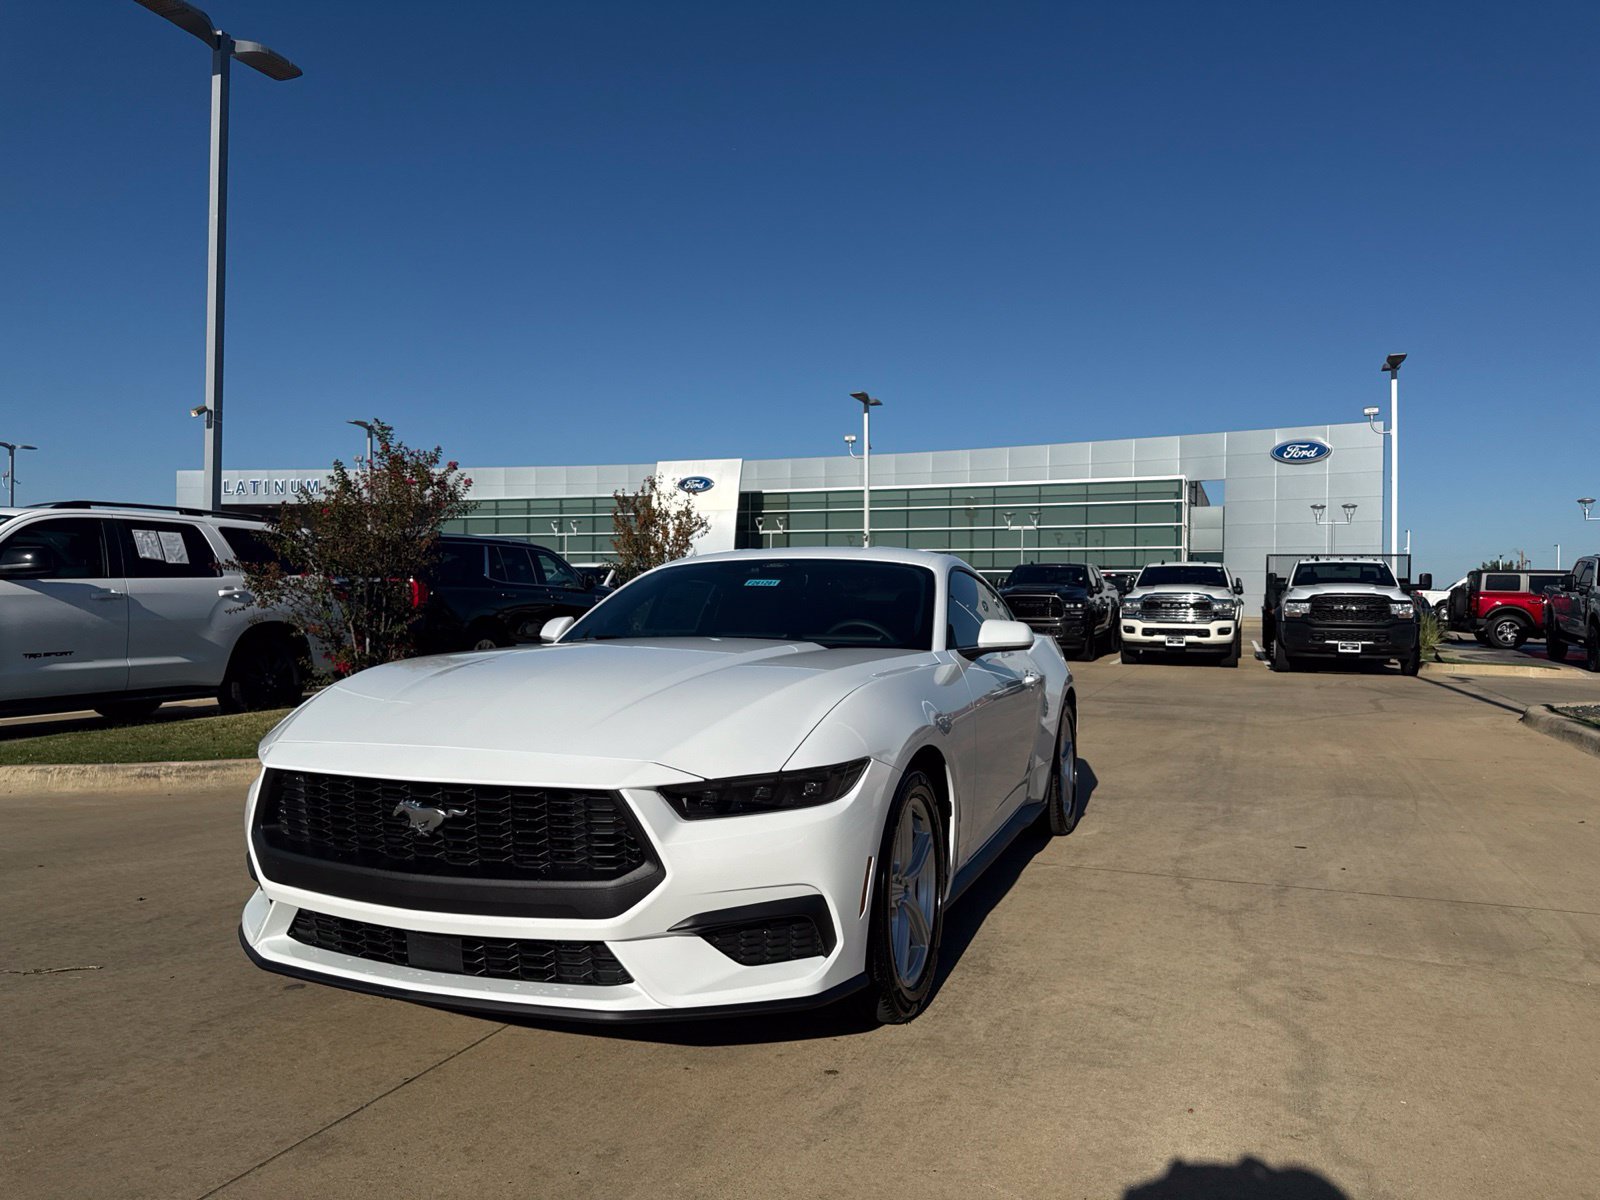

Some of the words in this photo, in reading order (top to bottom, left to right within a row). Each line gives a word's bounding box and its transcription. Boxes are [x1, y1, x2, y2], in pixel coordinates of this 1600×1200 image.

[1283, 444, 1319, 459] Ford
[221, 478, 320, 495] LATINUM
[684, 479, 706, 489] Ford
[23, 652, 41, 660] TRD
